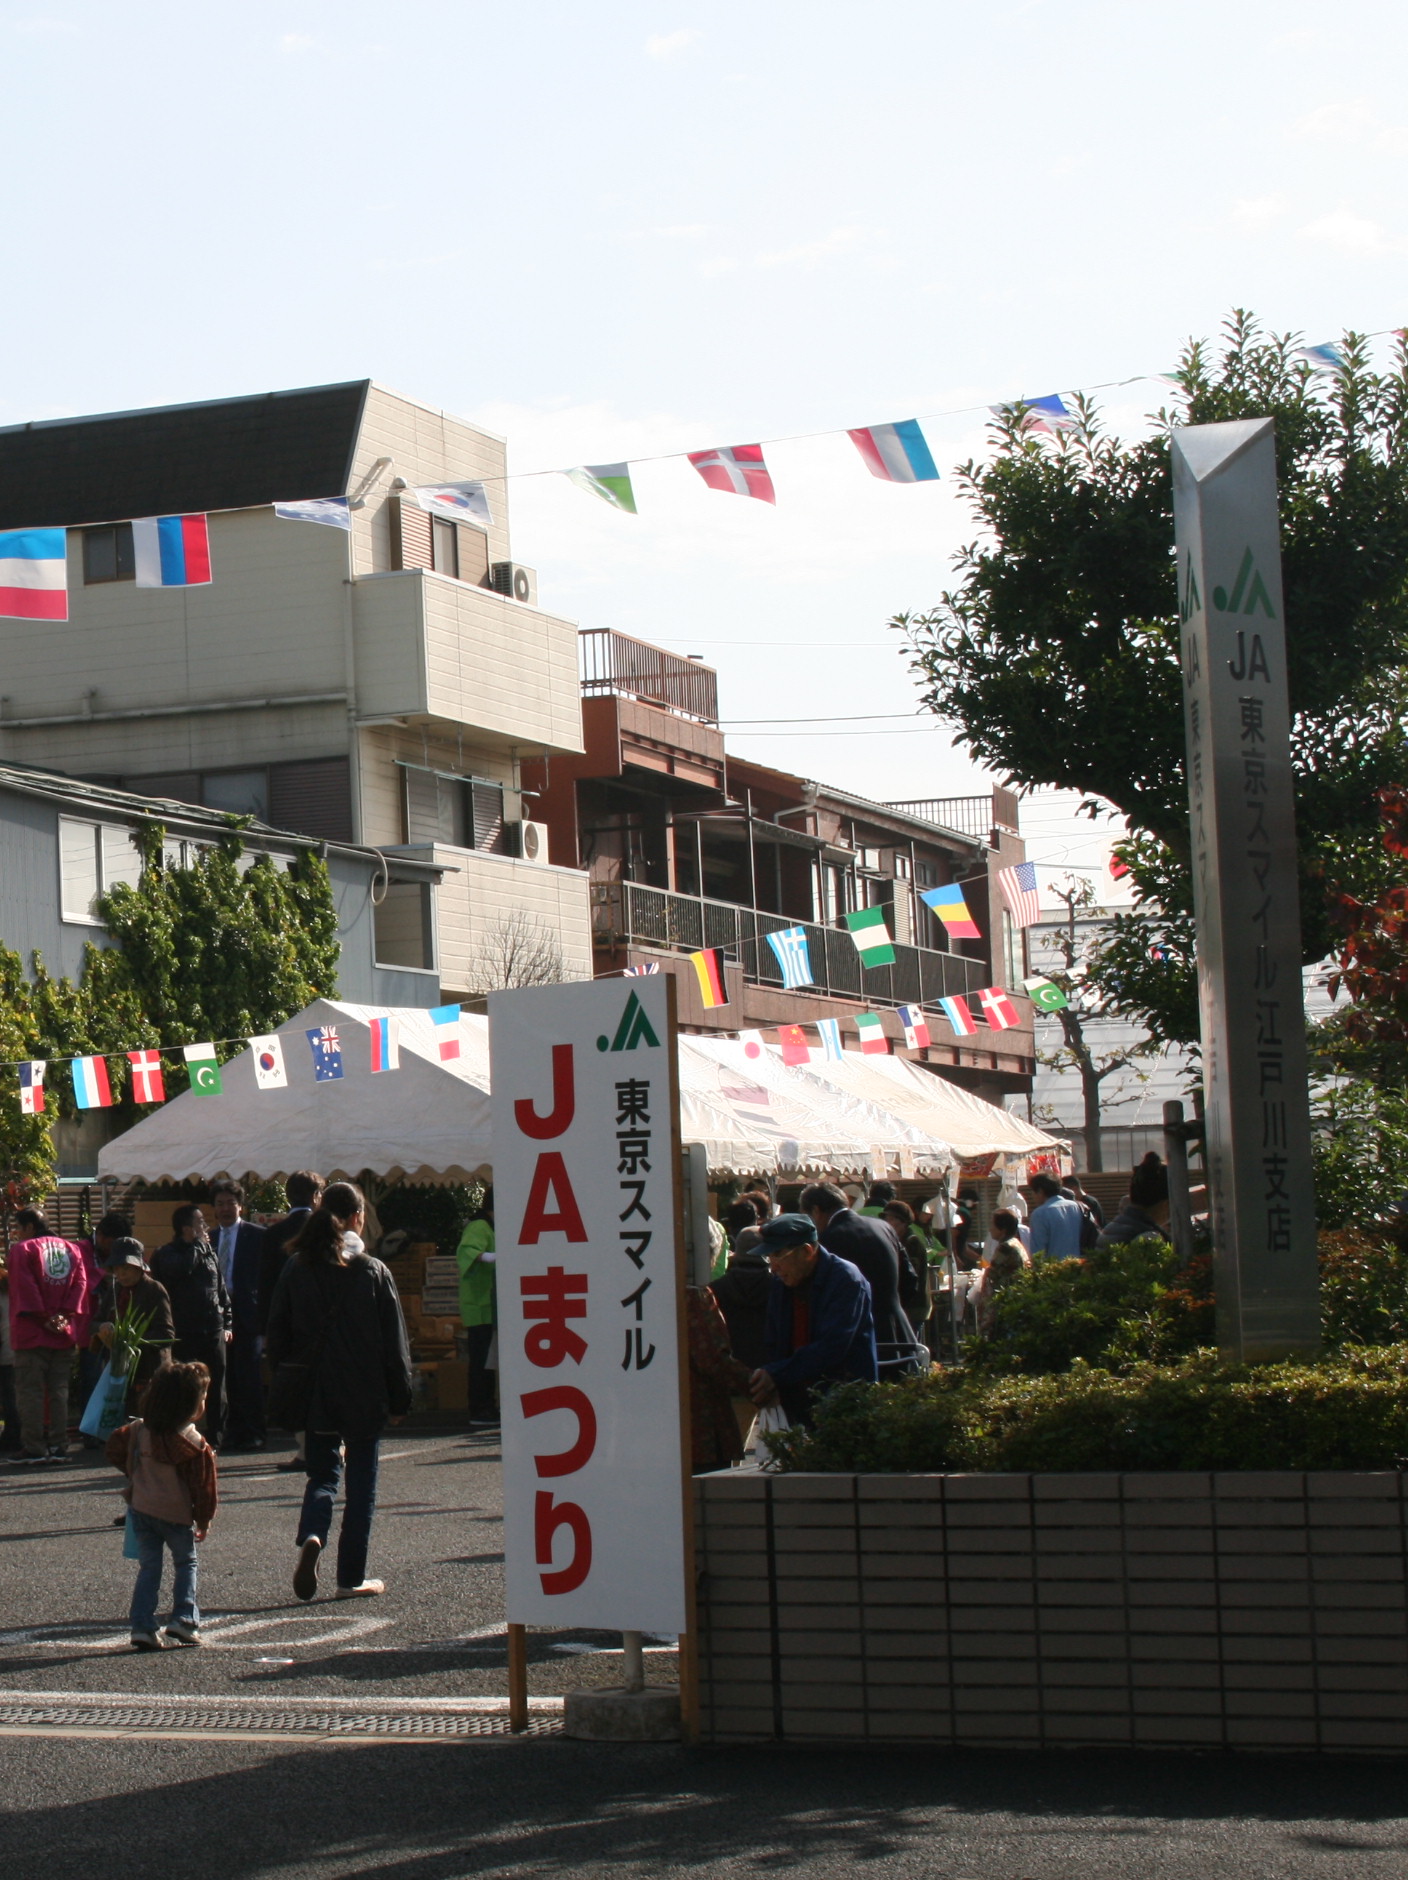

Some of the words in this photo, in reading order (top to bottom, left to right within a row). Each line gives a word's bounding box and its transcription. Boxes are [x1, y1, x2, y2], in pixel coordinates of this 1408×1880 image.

[513, 1043, 598, 1597] JAまつり
[613, 1078, 656, 1373] 東京スマイル
